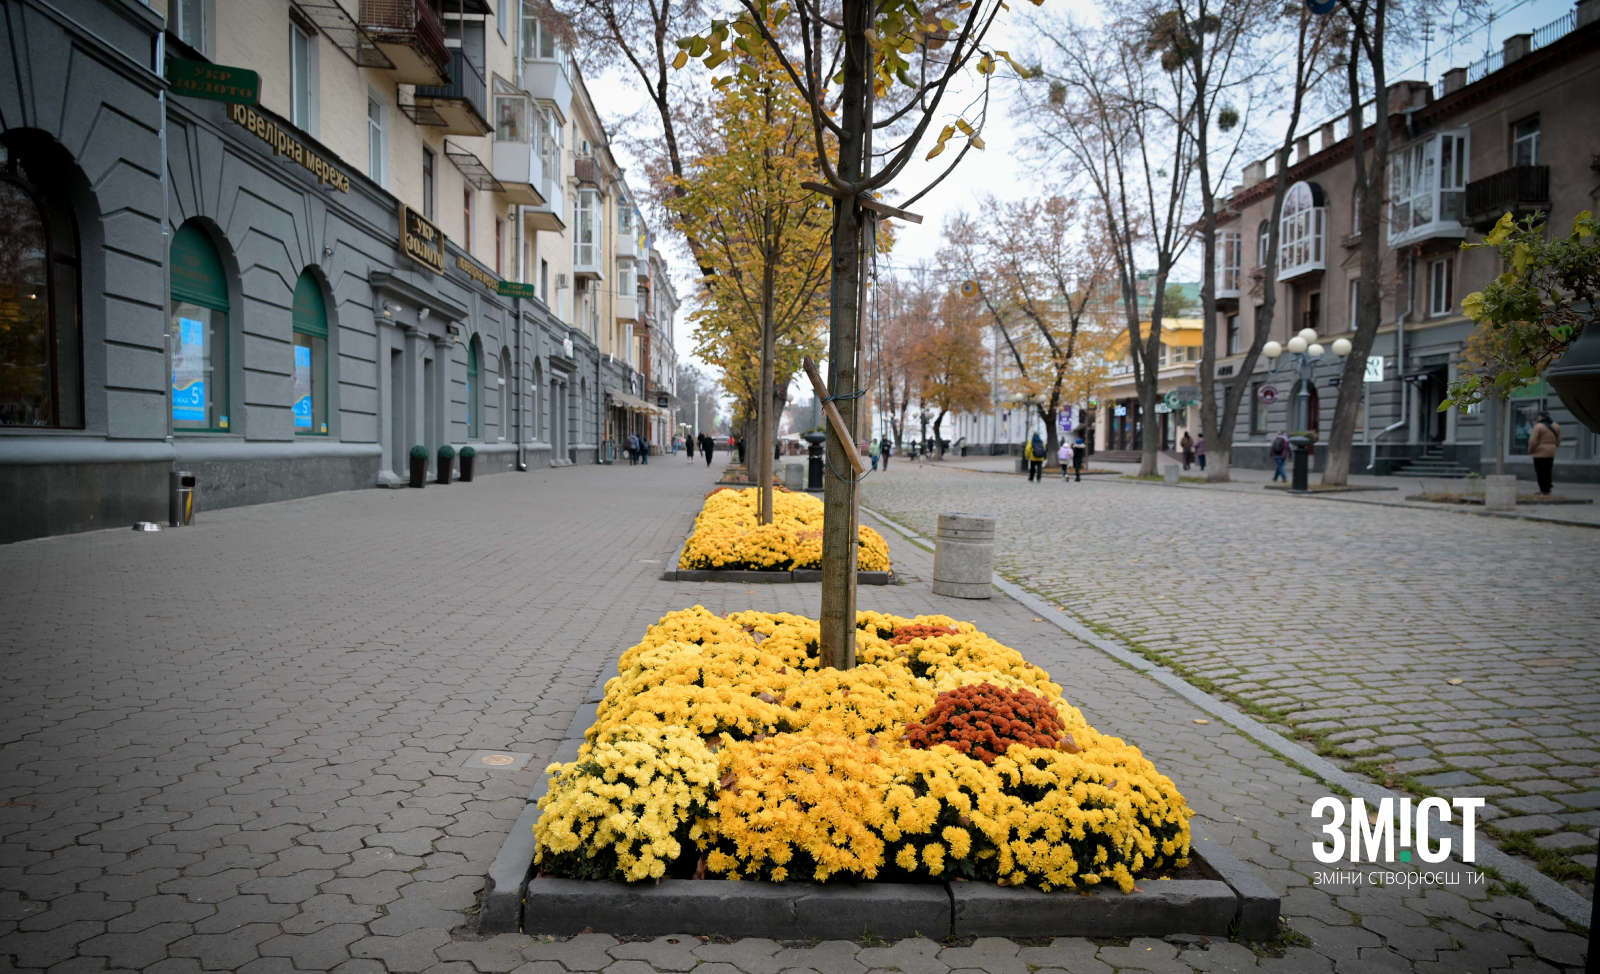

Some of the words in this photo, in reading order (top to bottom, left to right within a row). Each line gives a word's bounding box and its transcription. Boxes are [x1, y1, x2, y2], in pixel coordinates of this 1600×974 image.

[194, 67, 232, 82] УКР
[306, 149, 350, 194] мережа
[416, 217, 435, 242] УКР
[406, 232, 443, 269] ЗОЛОТО
